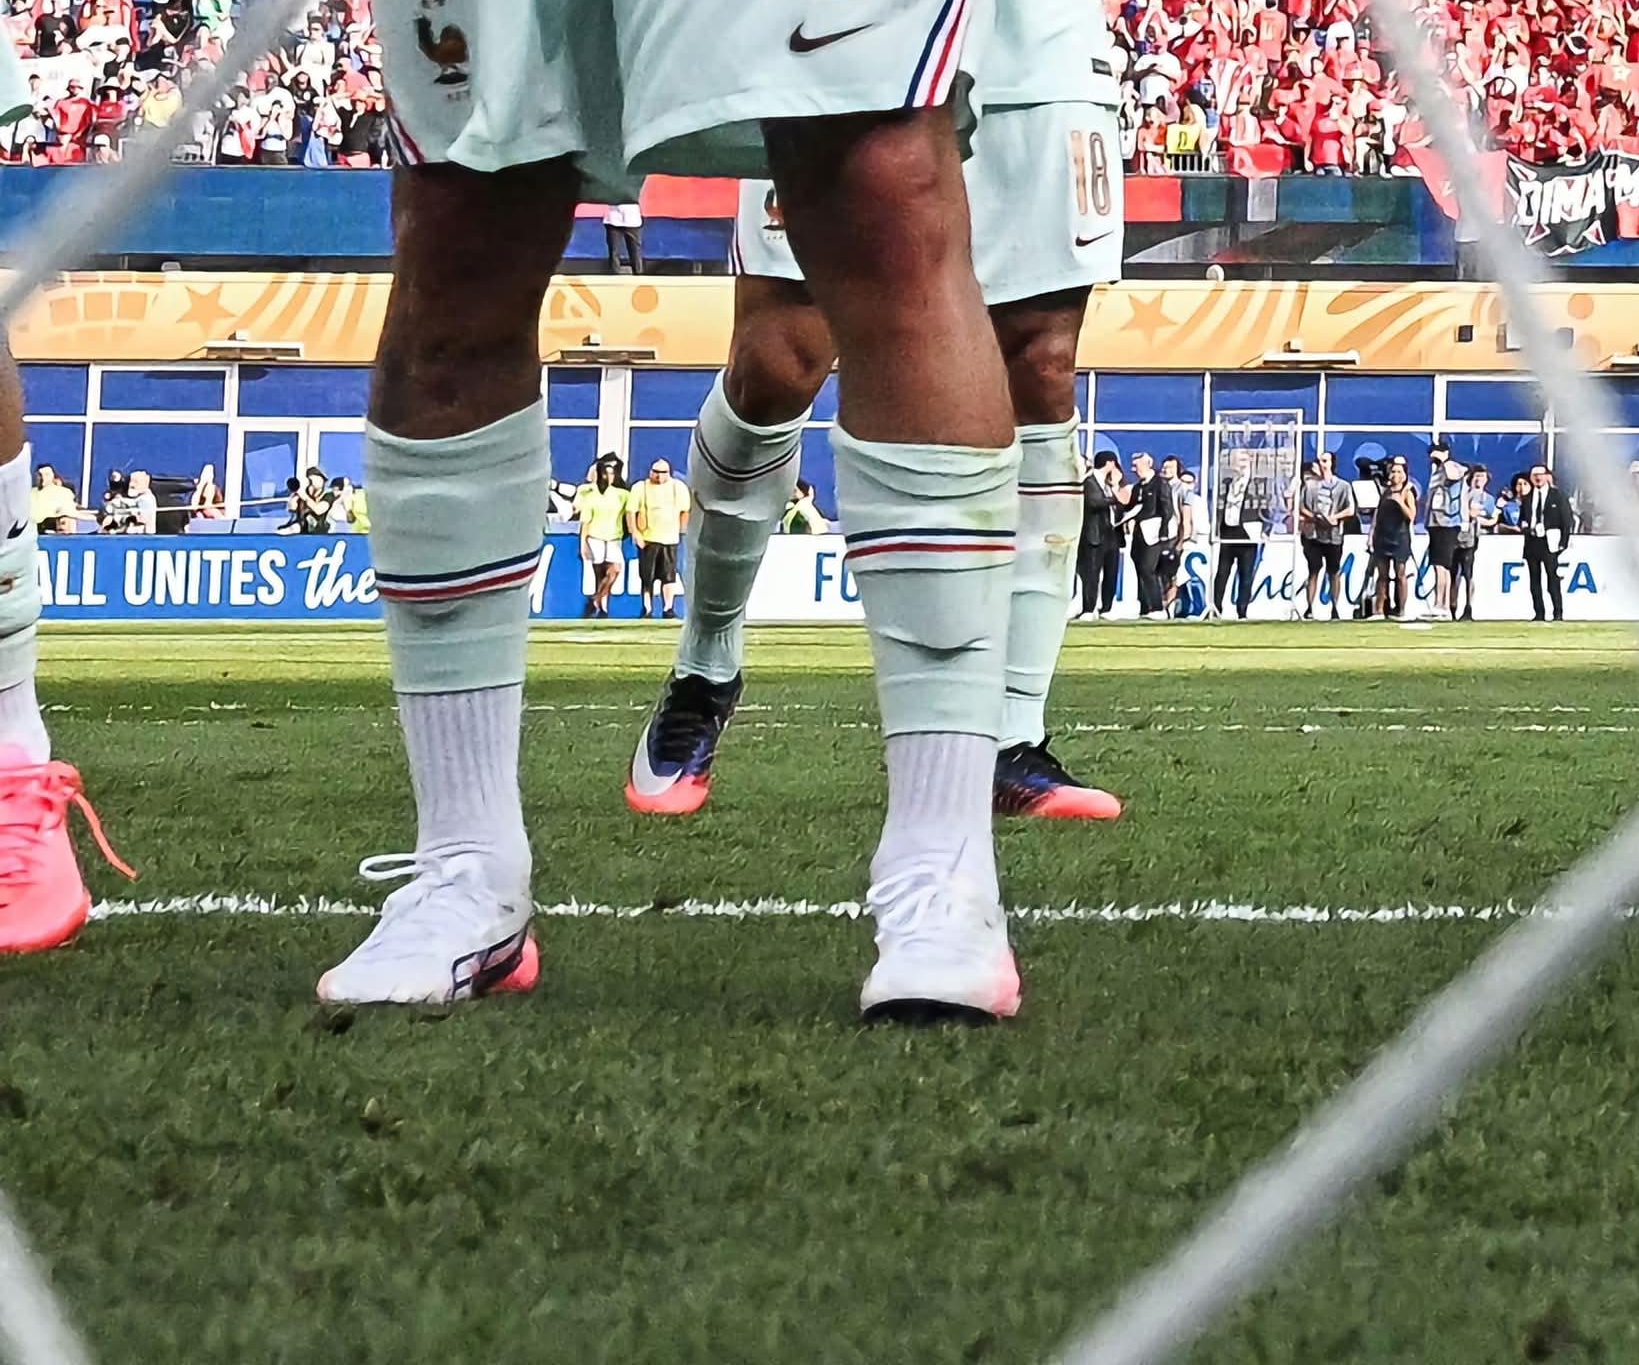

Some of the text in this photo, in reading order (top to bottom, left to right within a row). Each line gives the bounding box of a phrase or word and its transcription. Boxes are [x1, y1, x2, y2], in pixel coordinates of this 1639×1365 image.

[1069, 129, 1112, 217] 18
[1517, 172, 1608, 227] DIMA
[123, 548, 287, 607] UNITES
[297, 540, 381, 611] the
